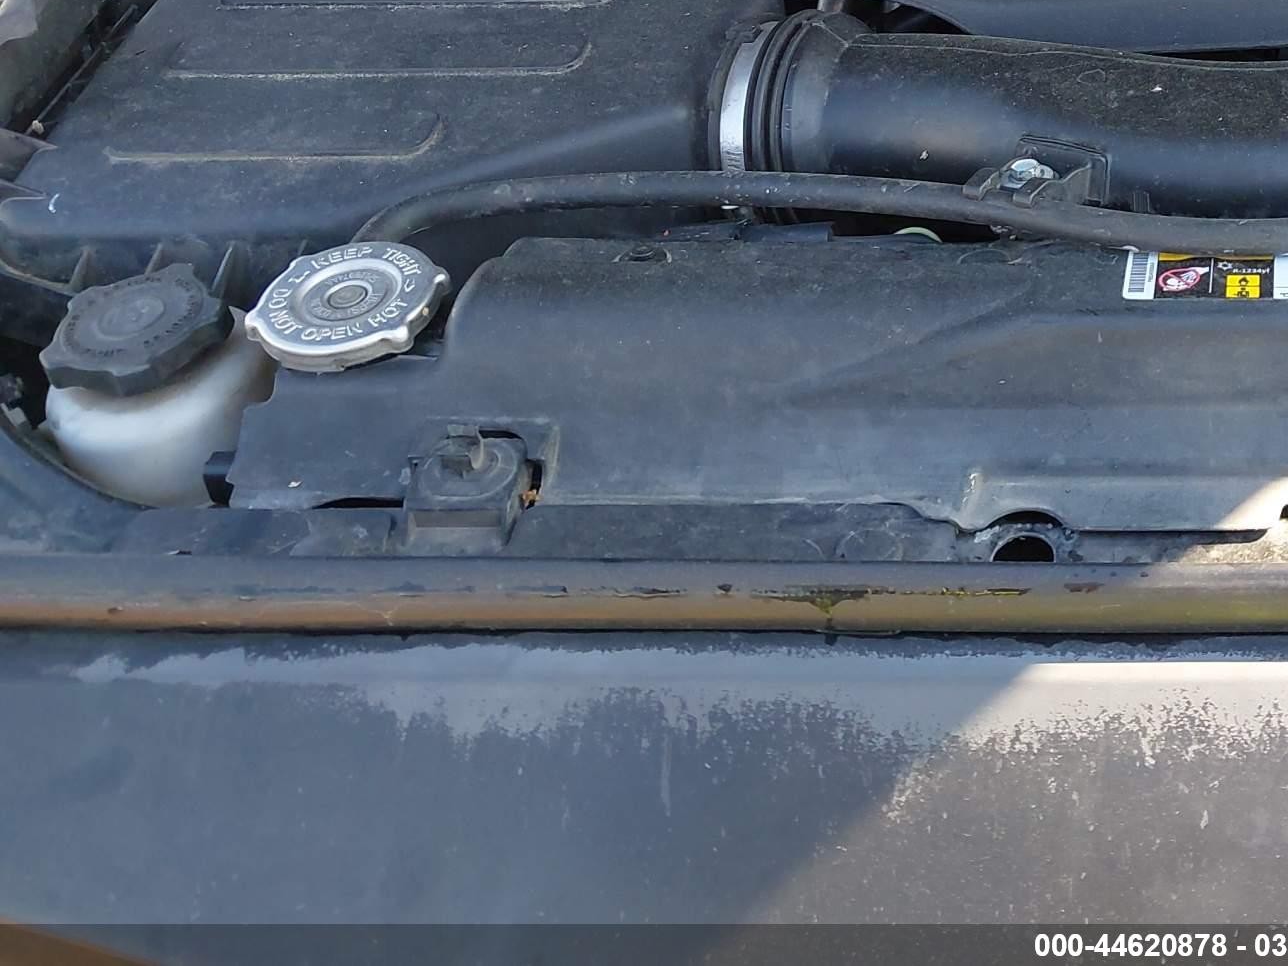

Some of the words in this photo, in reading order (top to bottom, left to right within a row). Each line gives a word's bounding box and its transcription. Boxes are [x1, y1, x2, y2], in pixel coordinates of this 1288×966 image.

[310, 245, 373, 270] KEEP
[381, 247, 423, 278] TIGHT
[268, 286, 292, 311] DO
[367, 297, 409, 328] HOT
[268, 307, 304, 336] NOT
[301, 323, 363, 342] OPEN
